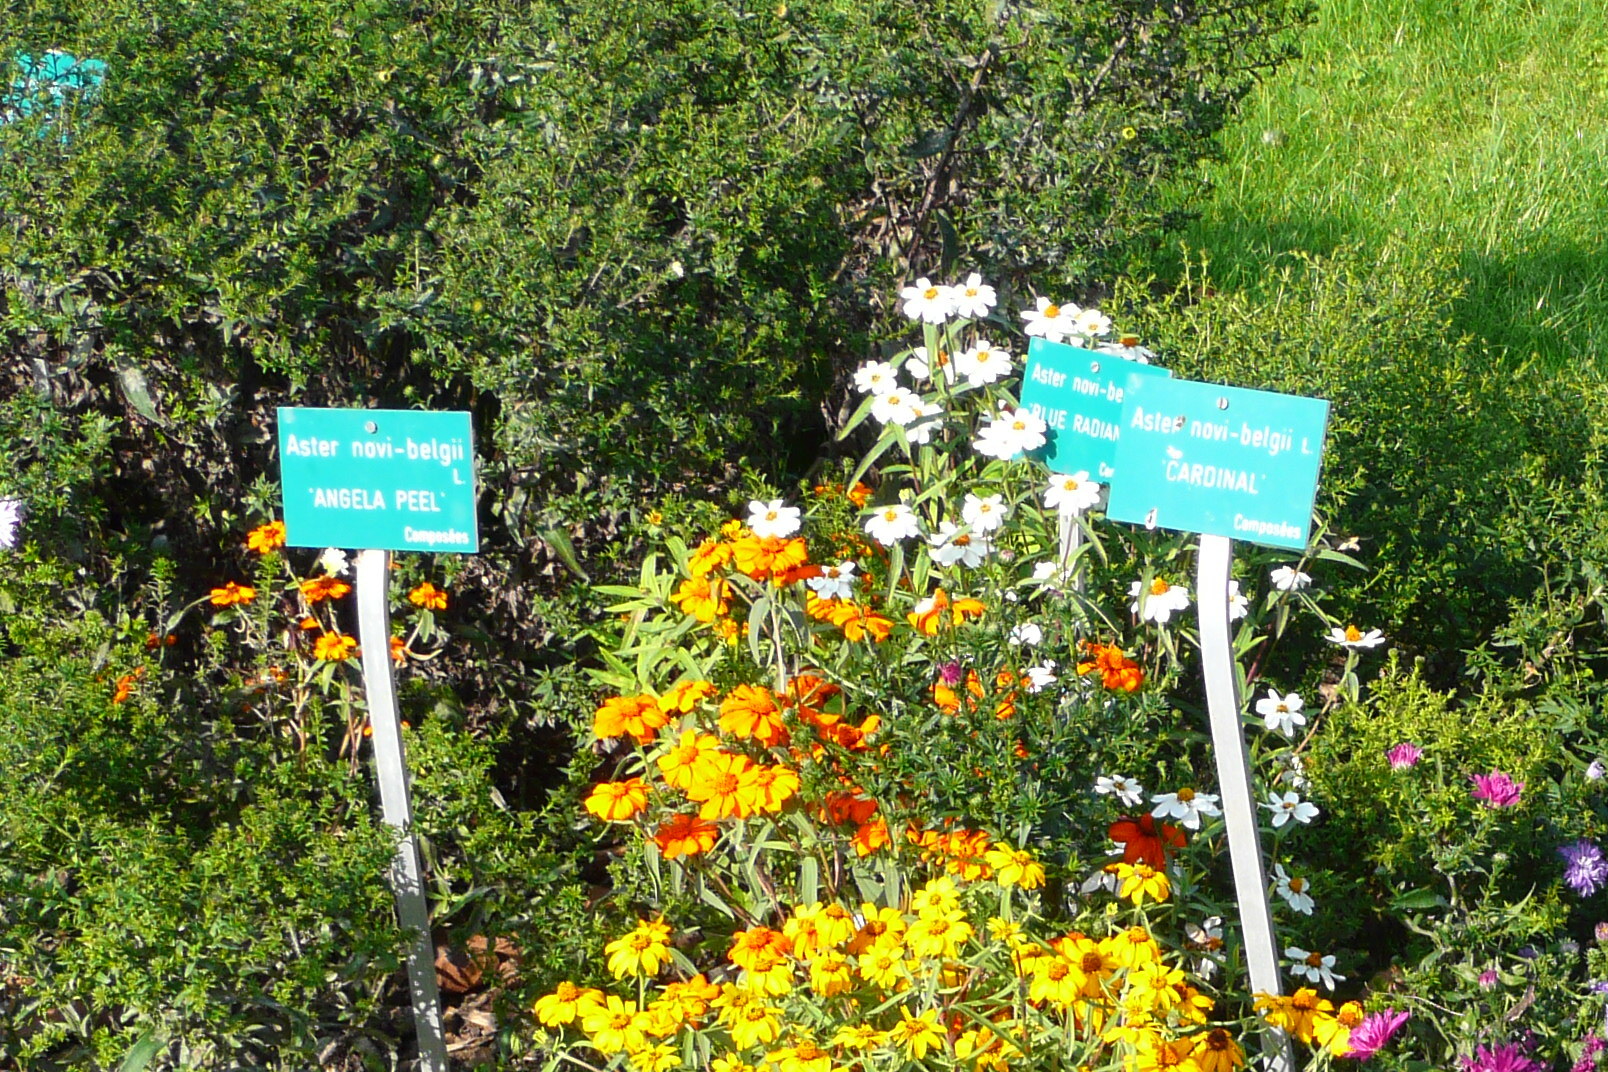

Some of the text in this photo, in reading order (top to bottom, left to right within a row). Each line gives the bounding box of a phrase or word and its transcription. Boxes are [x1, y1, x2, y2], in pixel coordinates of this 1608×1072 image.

[1032, 362, 1124, 403] Aster novi-be
[1073, 413, 1120, 441] RADIAN
[1131, 407, 1184, 434] Aster
[1190, 412, 1292, 456] novi-belgii
[286, 434, 463, 467] Aster novi-belgii
[404, 526, 469, 545] Composées
[1233, 513, 1301, 540] Composées
